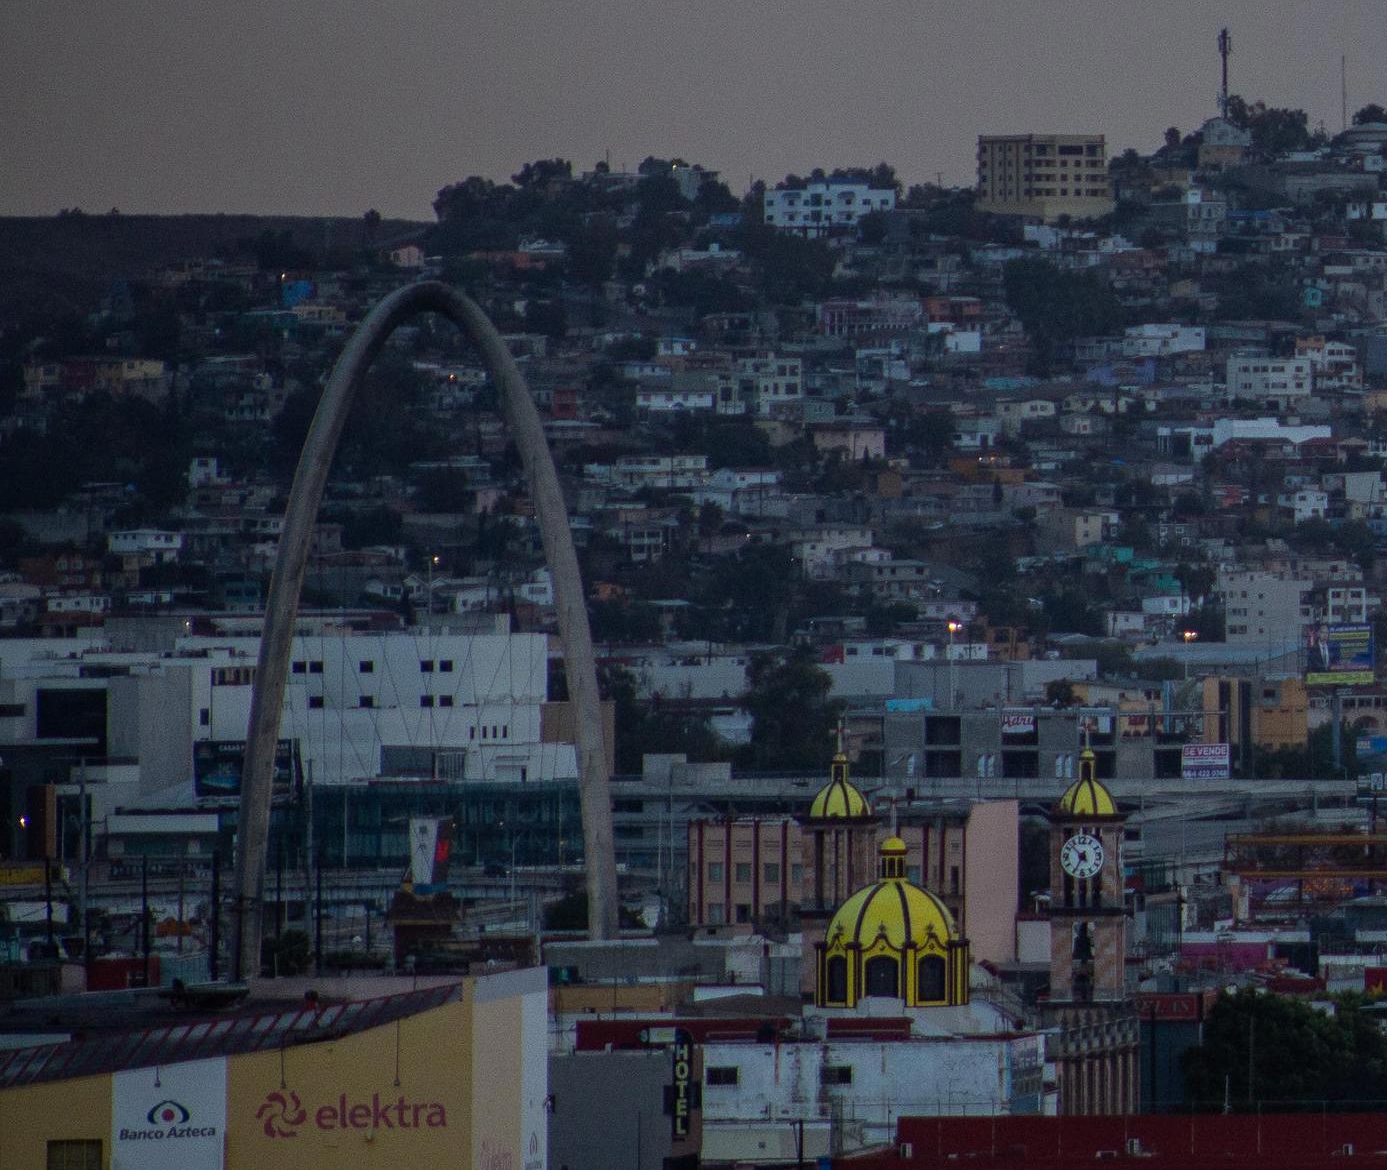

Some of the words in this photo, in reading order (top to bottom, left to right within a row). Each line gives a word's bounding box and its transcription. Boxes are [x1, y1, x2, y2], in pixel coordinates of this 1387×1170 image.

[1183, 746, 1196, 756] SE
[1197, 745, 1228, 756] VENDE
[675, 1044, 689, 1134] HOTEL
[315, 1093, 448, 1130] elektra
[119, 1127, 165, 1141] Banco
[167, 1125, 217, 1140] Azteca
